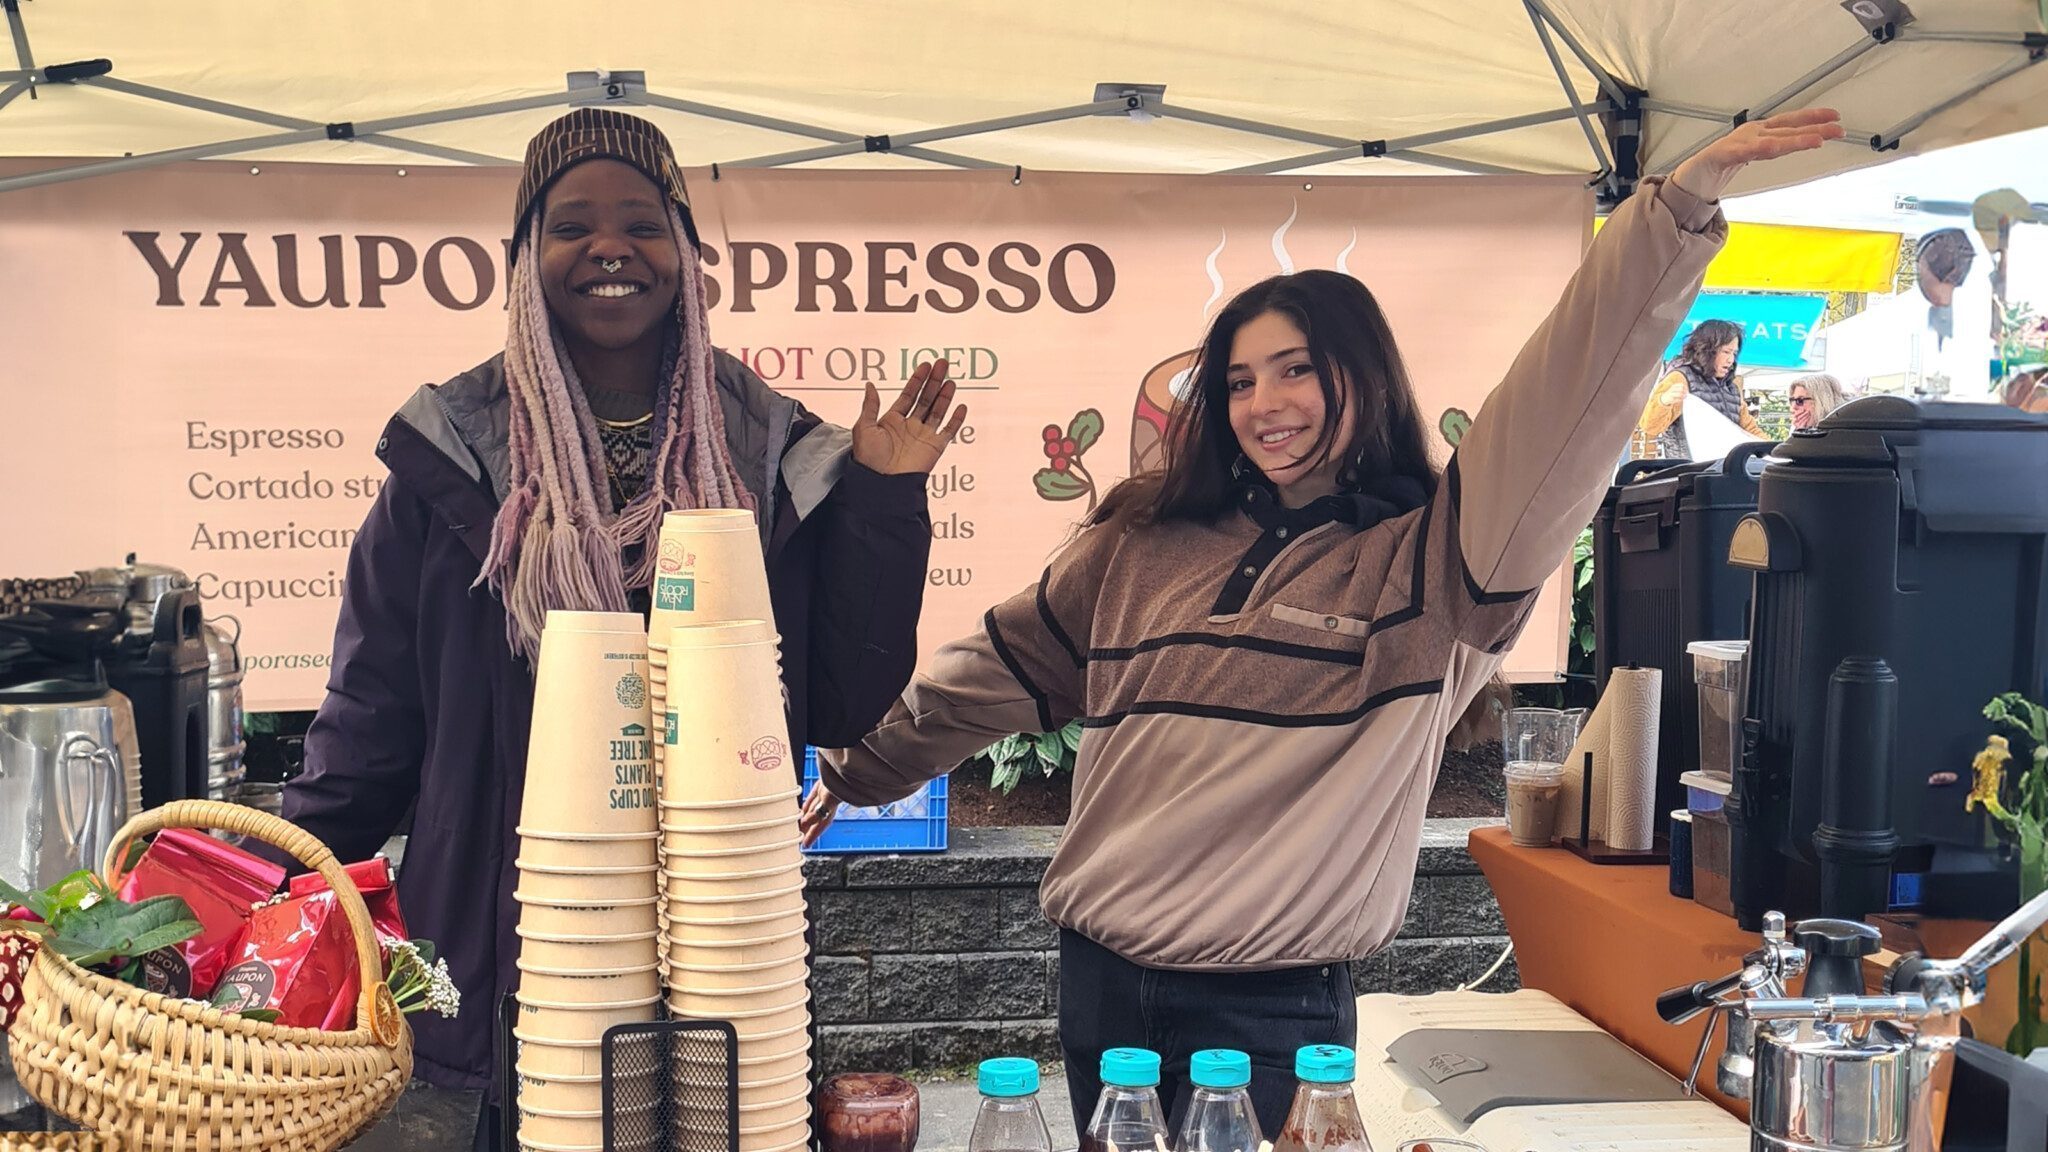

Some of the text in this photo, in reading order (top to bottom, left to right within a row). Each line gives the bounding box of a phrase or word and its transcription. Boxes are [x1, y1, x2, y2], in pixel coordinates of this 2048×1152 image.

[122, 230, 514, 311] YAUPO
[825, 347, 887, 381] OR
[186, 420, 345, 457] Espresso
[188, 469, 382, 500] Cortado st
[927, 464, 975, 499] yle
[190, 521, 358, 550] American
[196, 570, 344, 608] Capucci
[610, 740, 637, 760] TREE
[615, 764, 652, 785] PLANTS
[610, 788, 640, 809] CUPS
[147, 952, 183, 975] UPON
